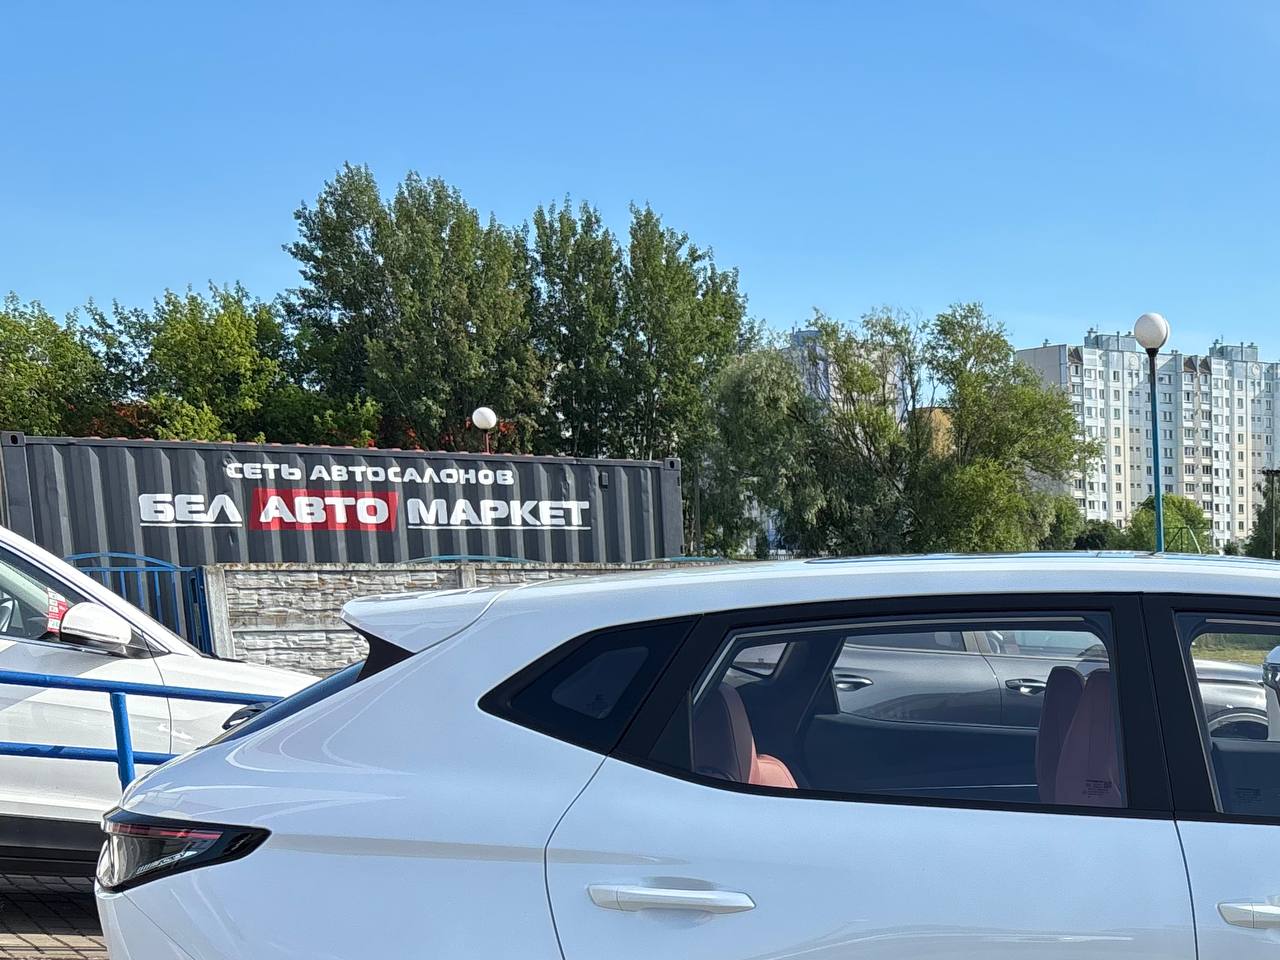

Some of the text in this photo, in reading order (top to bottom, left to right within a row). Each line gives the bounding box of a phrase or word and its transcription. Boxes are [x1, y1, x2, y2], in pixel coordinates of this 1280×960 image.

[226, 463, 514, 485] СЕТЬ АВТОСАЛОНОВ
[139, 494, 589, 525] БЕЛ АВТО МАРКЕТ
